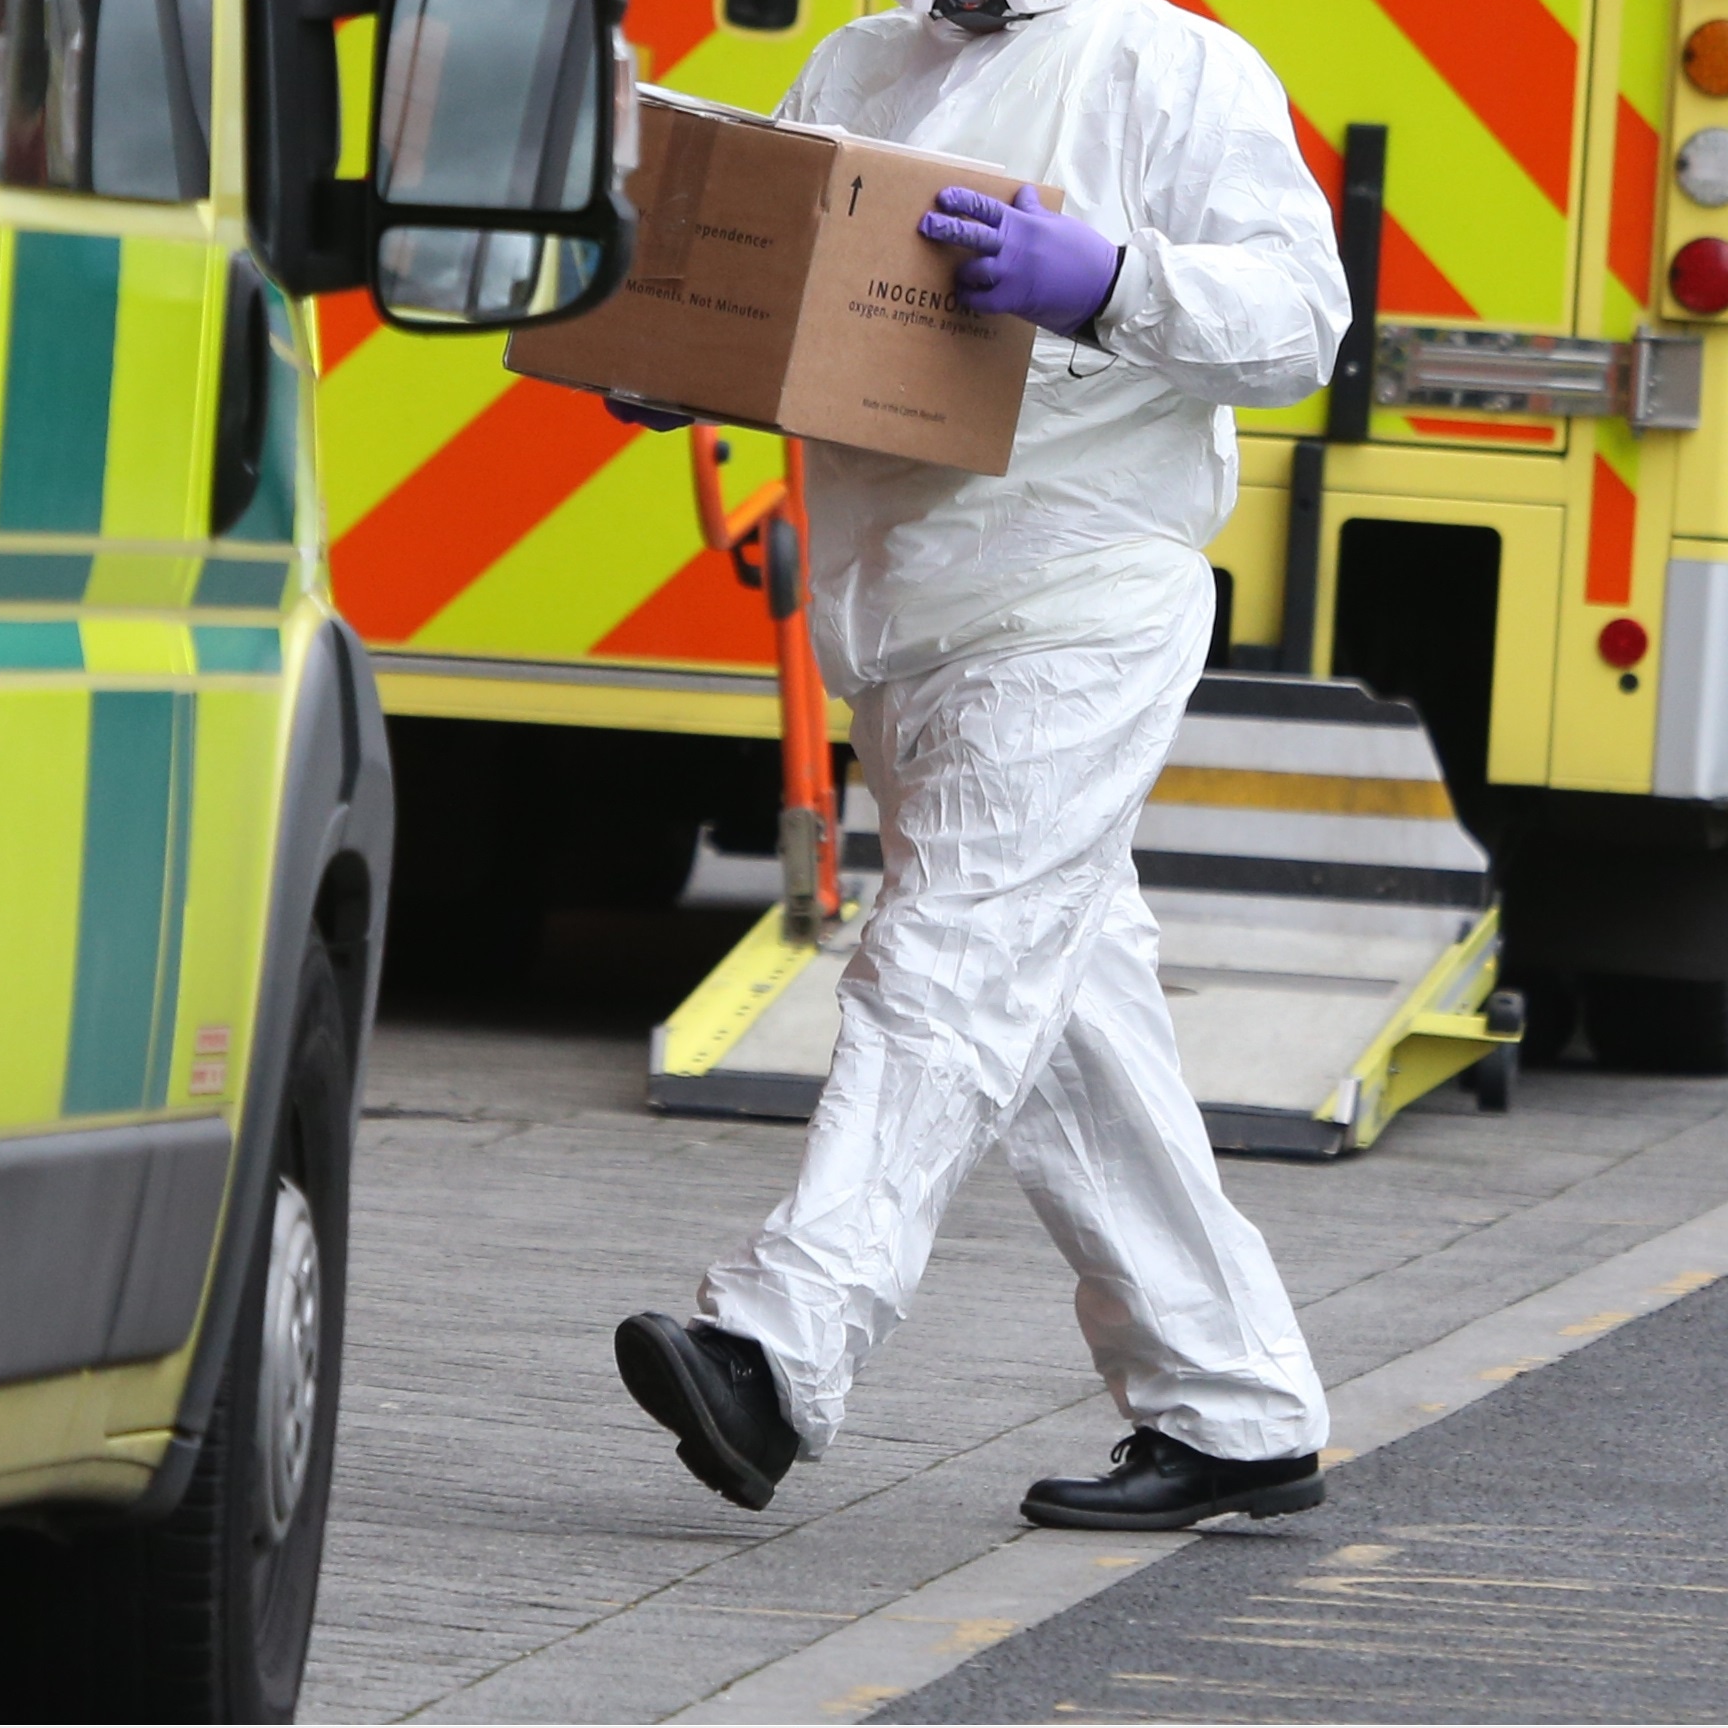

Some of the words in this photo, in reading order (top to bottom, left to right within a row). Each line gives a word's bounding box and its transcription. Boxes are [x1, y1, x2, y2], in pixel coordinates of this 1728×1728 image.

[694, 223, 770, 249] ependence
[625, 278, 685, 305] Moments,
[689, 292, 712, 309] Not
[867, 279, 979, 319] INOGENO
[862, 398, 879, 410] Made
